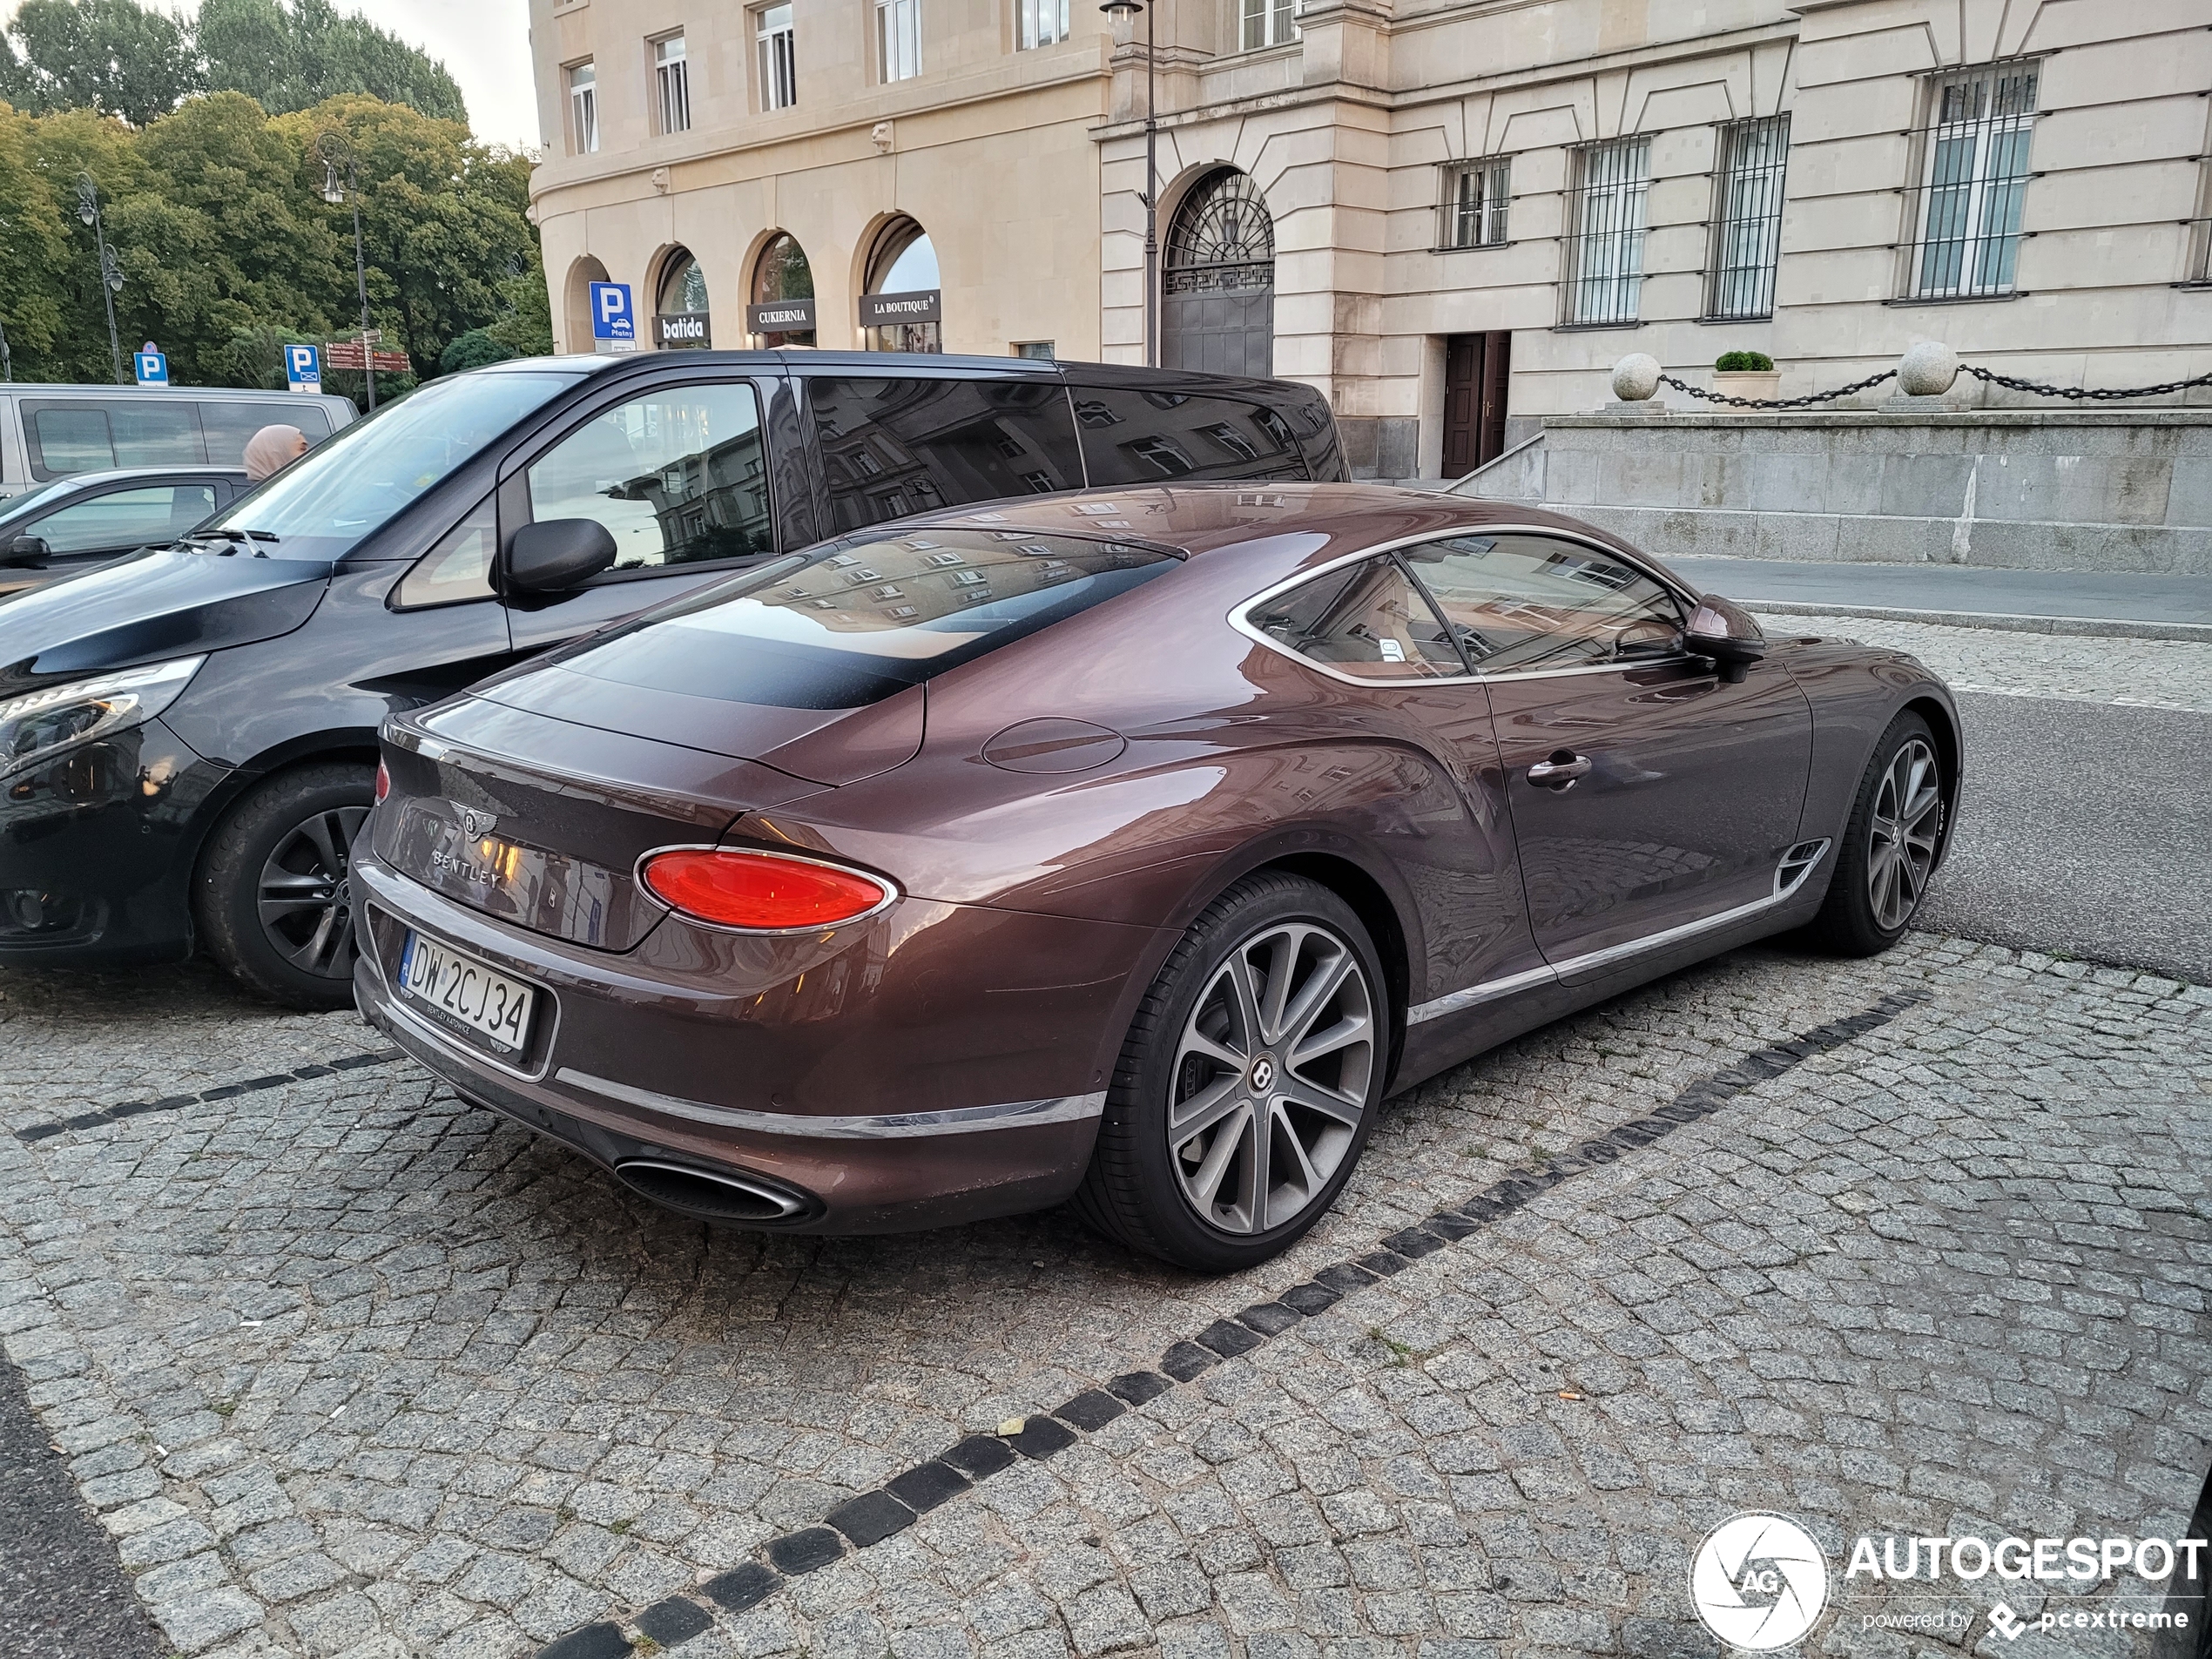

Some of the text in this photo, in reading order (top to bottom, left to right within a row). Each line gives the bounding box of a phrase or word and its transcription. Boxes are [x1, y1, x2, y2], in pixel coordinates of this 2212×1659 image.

[599, 287, 624, 323] P
[759, 308, 806, 325] CUKIERNIA
[874, 300, 929, 314] LA BOUTIQUE
[611, 329, 632, 338] Płatny
[662, 317, 704, 339] batida
[142, 355, 160, 378] P
[292, 348, 312, 372] P
[433, 851, 502, 889] BENTLEY
[402, 962, 408, 976] PL
[412, 941, 526, 1042] DW 2CJ34
[427, 1004, 471, 1035] BENTLEY KATOWICE
